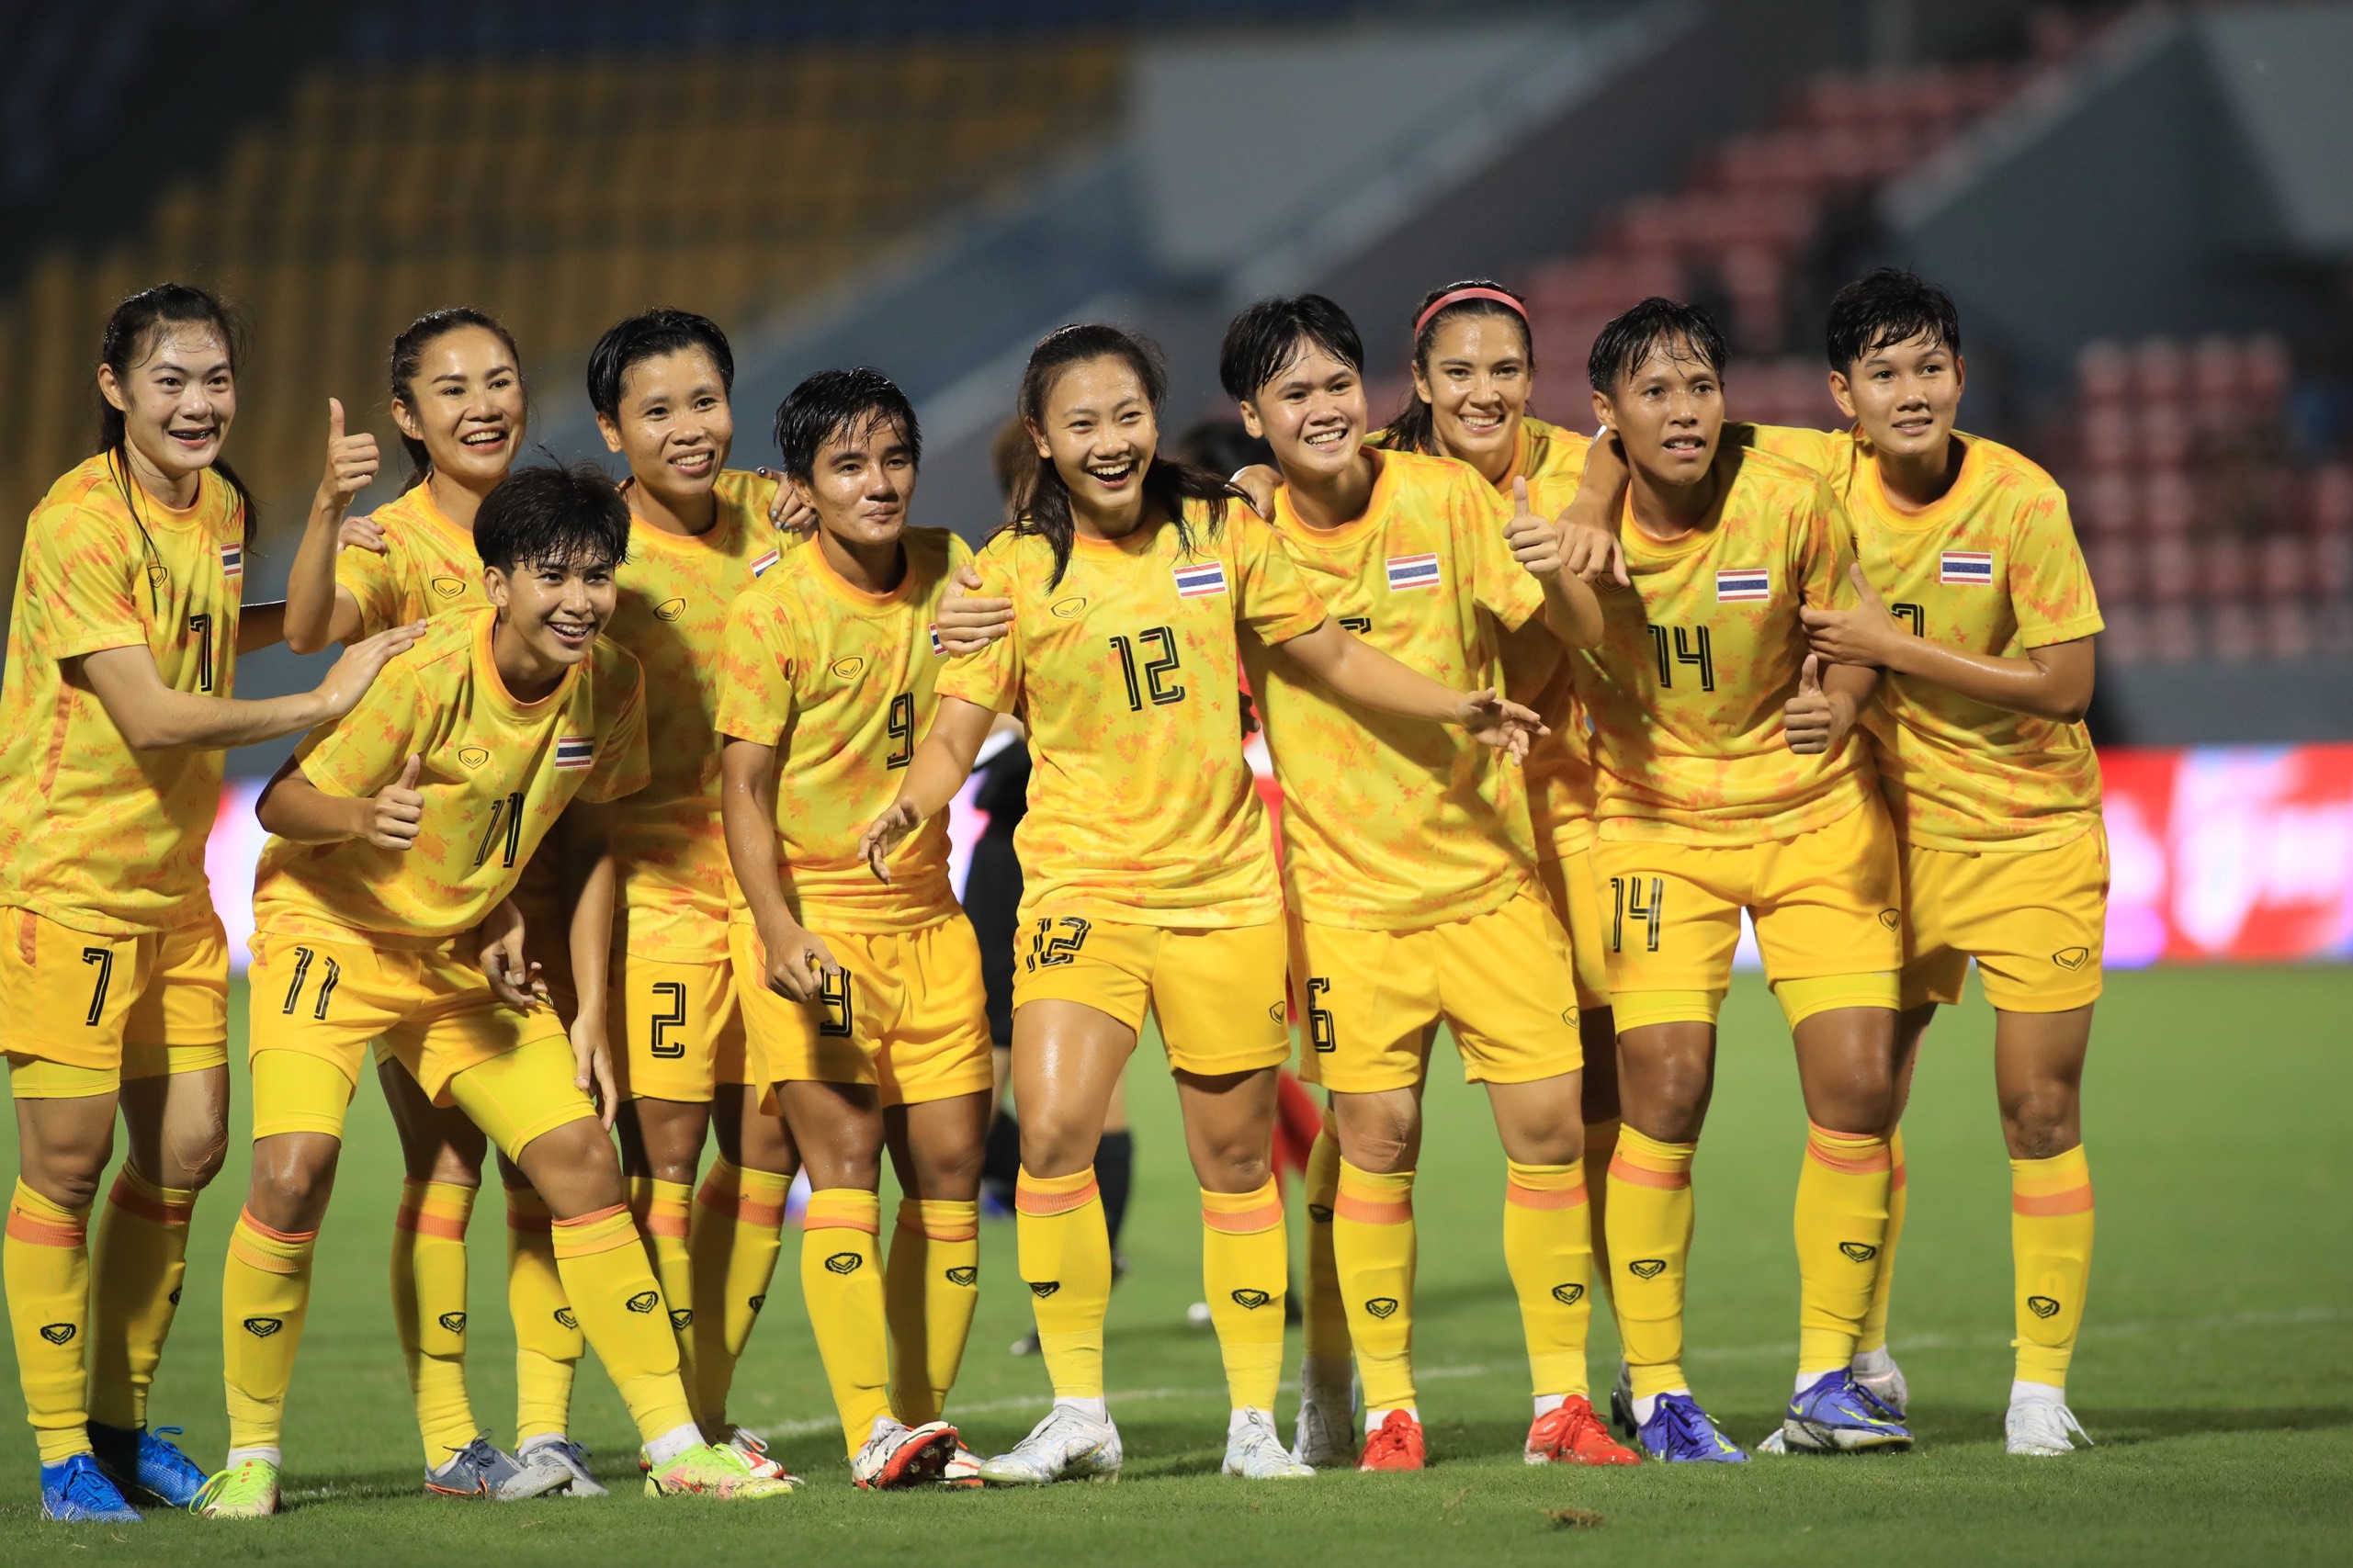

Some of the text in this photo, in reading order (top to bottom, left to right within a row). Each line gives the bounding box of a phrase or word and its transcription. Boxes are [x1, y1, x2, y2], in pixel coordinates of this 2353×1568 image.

[189, 613, 212, 692] 7
[1109, 626, 1186, 712] 12
[1646, 624, 1715, 692] 14
[887, 692, 914, 771] 9
[473, 792, 526, 868] 11
[1026, 916, 1092, 974] 12
[1610, 875, 1664, 953] 14
[82, 947, 114, 1027] 7
[282, 946, 340, 1021] 11
[650, 982, 686, 1059] 2
[819, 965, 853, 1038] 9
[1306, 977, 1337, 1053] 6
